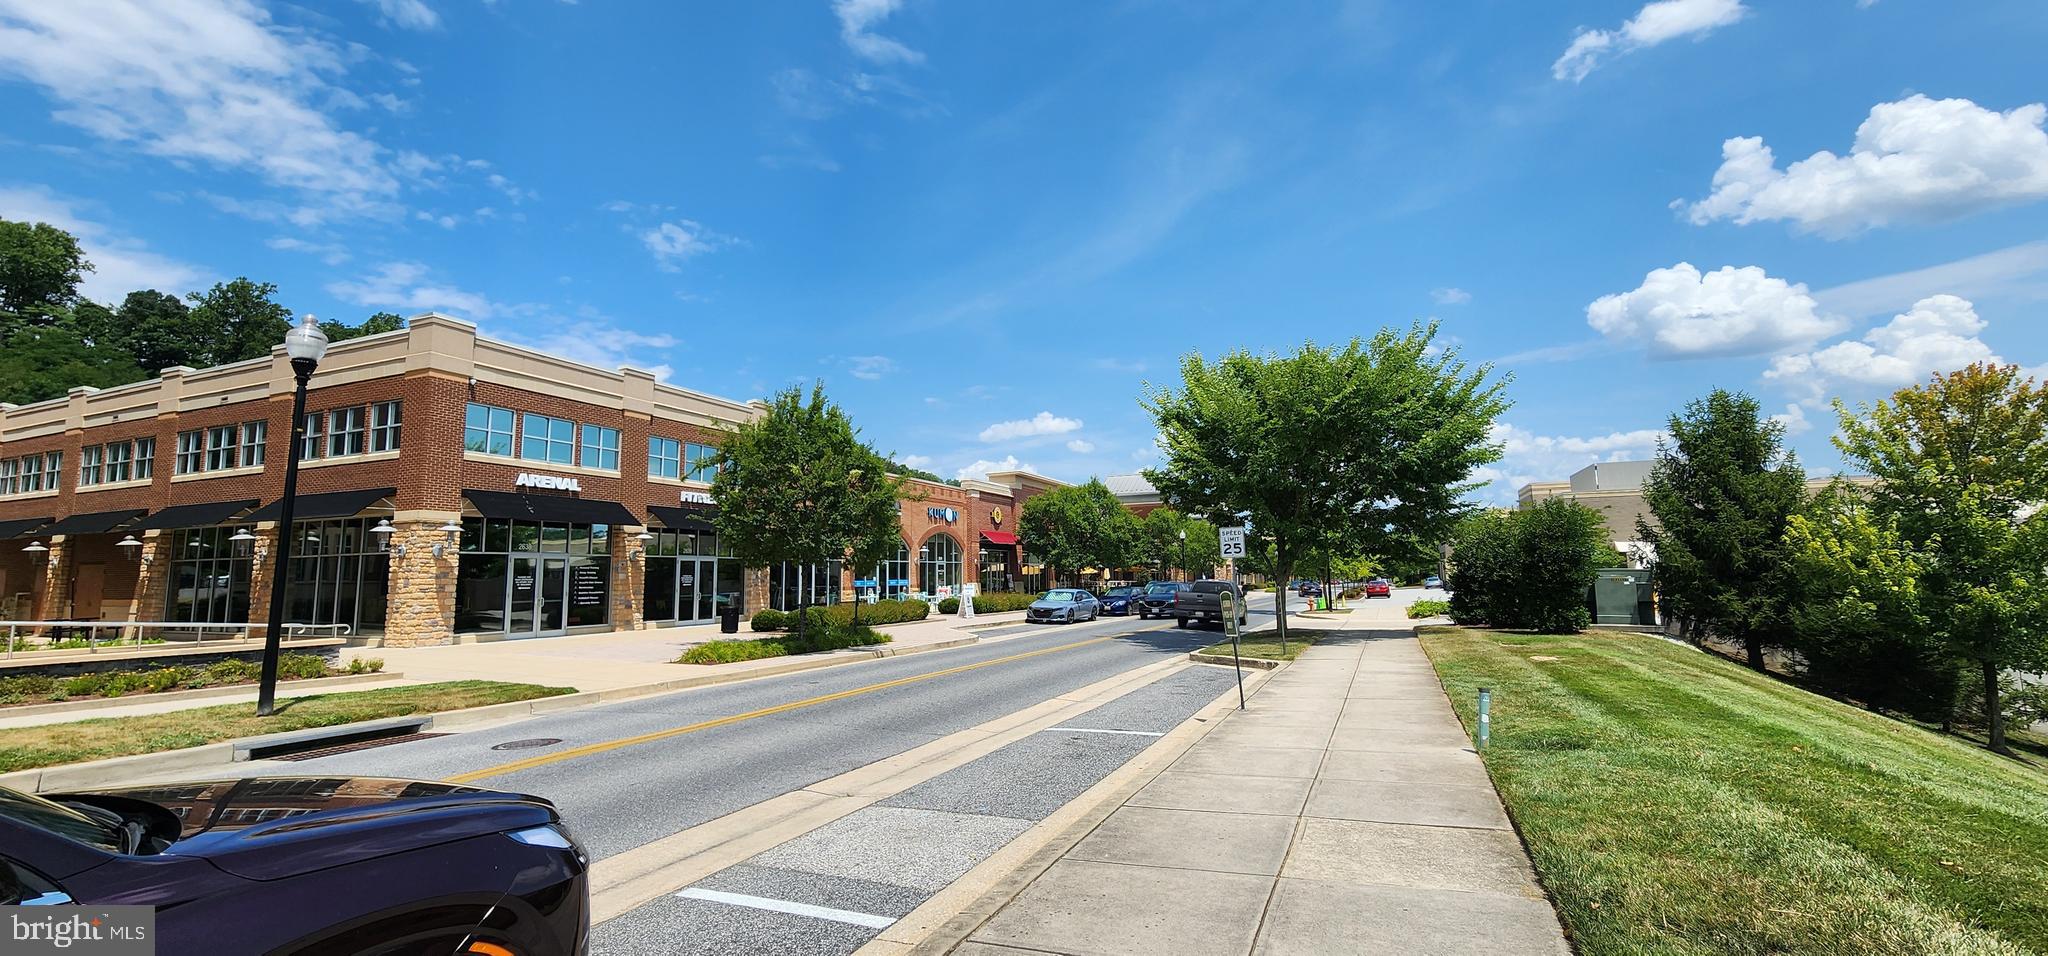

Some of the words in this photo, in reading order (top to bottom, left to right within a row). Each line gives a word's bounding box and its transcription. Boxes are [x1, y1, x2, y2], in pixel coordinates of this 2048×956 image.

[516, 473, 581, 491] ARENAL
[927, 507, 959, 523] KUMON
[1224, 543, 1242, 554] 25
